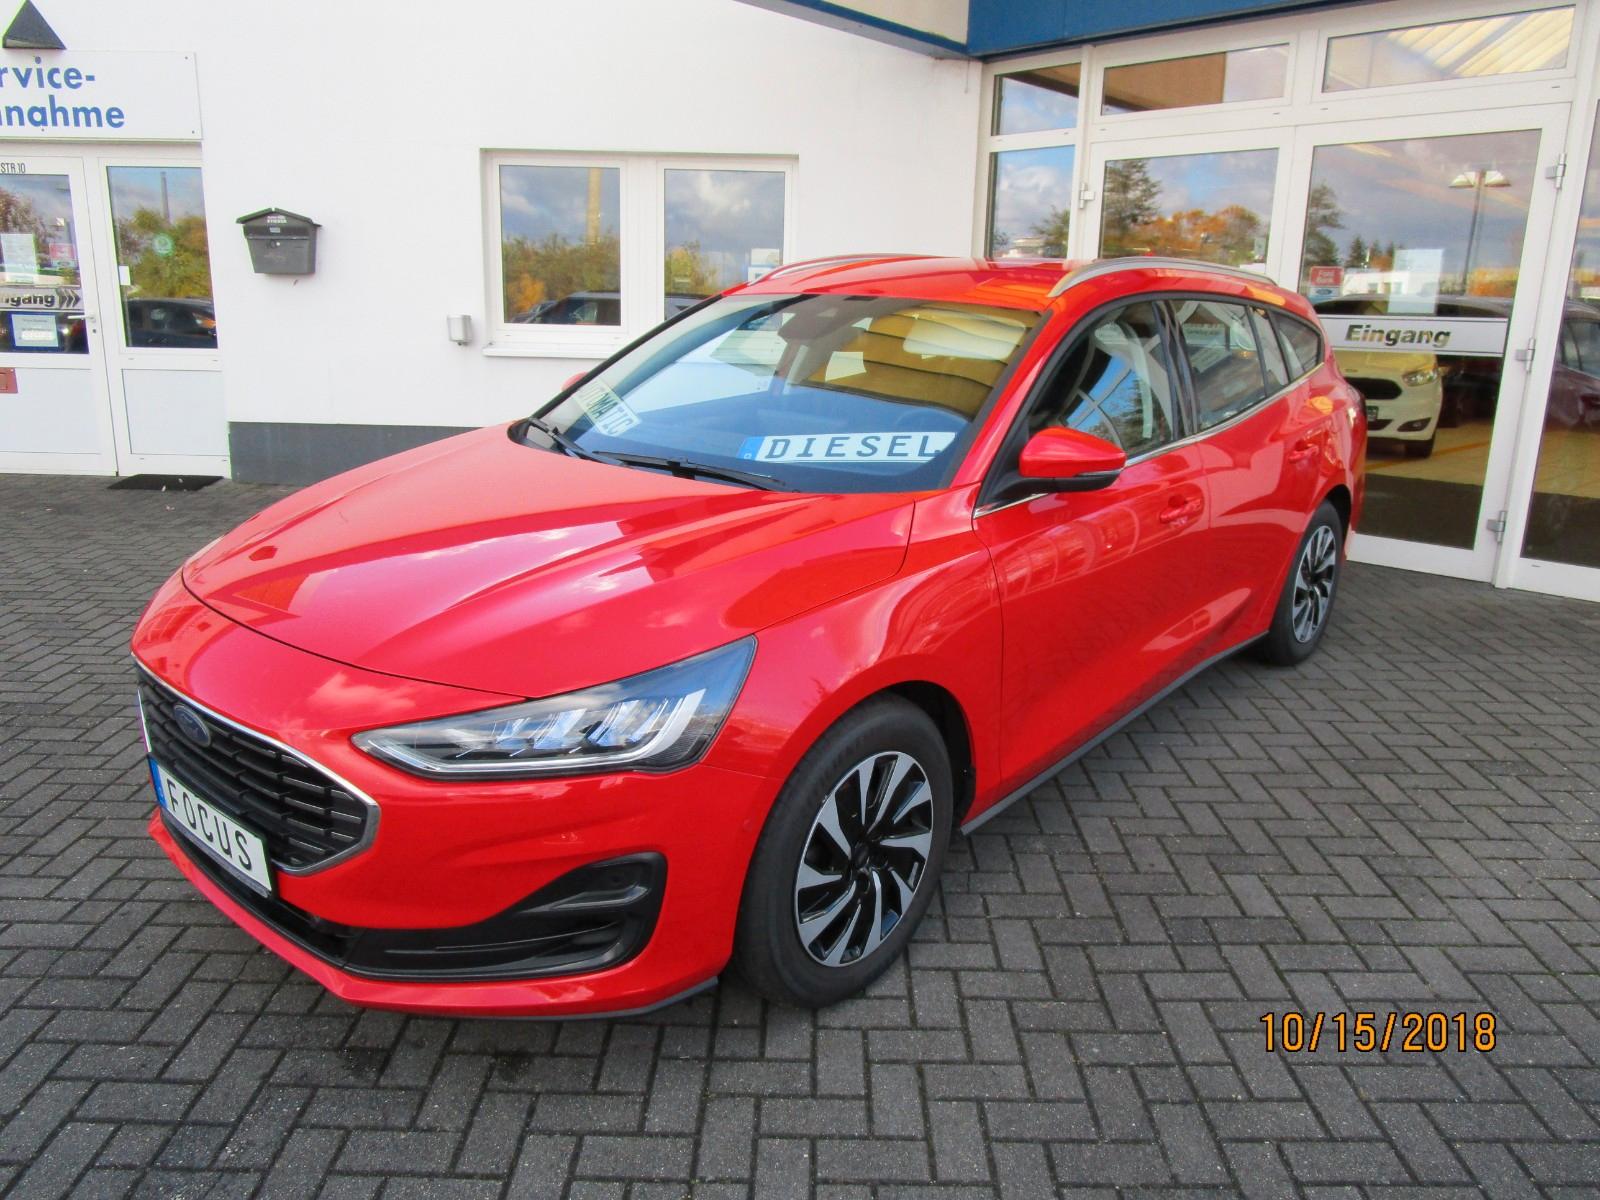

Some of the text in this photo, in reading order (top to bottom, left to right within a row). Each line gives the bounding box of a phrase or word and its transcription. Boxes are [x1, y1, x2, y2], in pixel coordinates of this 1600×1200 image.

[0, 94, 125, 128] nahme
[1344, 324, 1451, 348] Eingang
[765, 435, 942, 458] DIESEL
[166, 778, 252, 872] FOCUS
